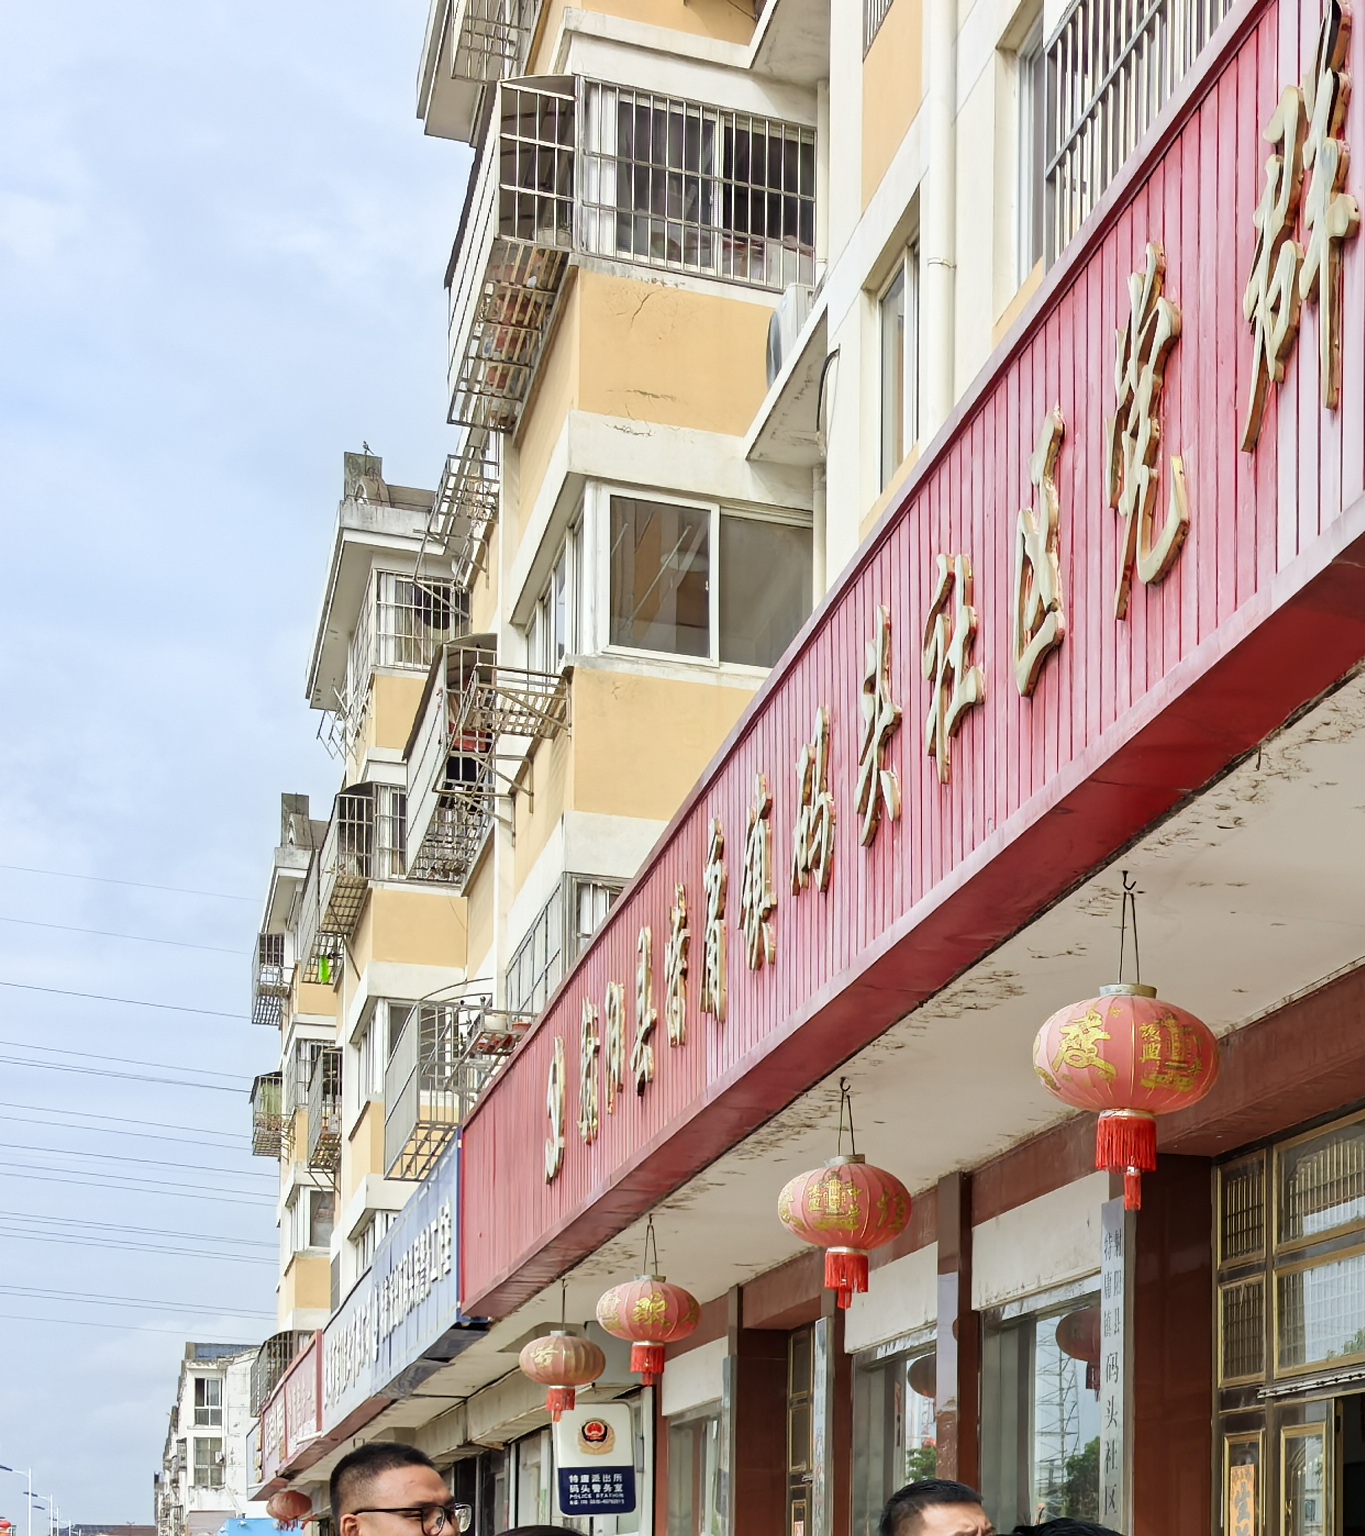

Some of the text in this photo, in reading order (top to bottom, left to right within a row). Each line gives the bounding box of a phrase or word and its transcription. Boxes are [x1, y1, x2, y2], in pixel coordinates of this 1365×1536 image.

[1103, 1232, 1113, 1338] 特庸镇
[1113, 1227, 1123, 1335] 射阳县
[569, 1484, 624, 1493] 码头警务室
